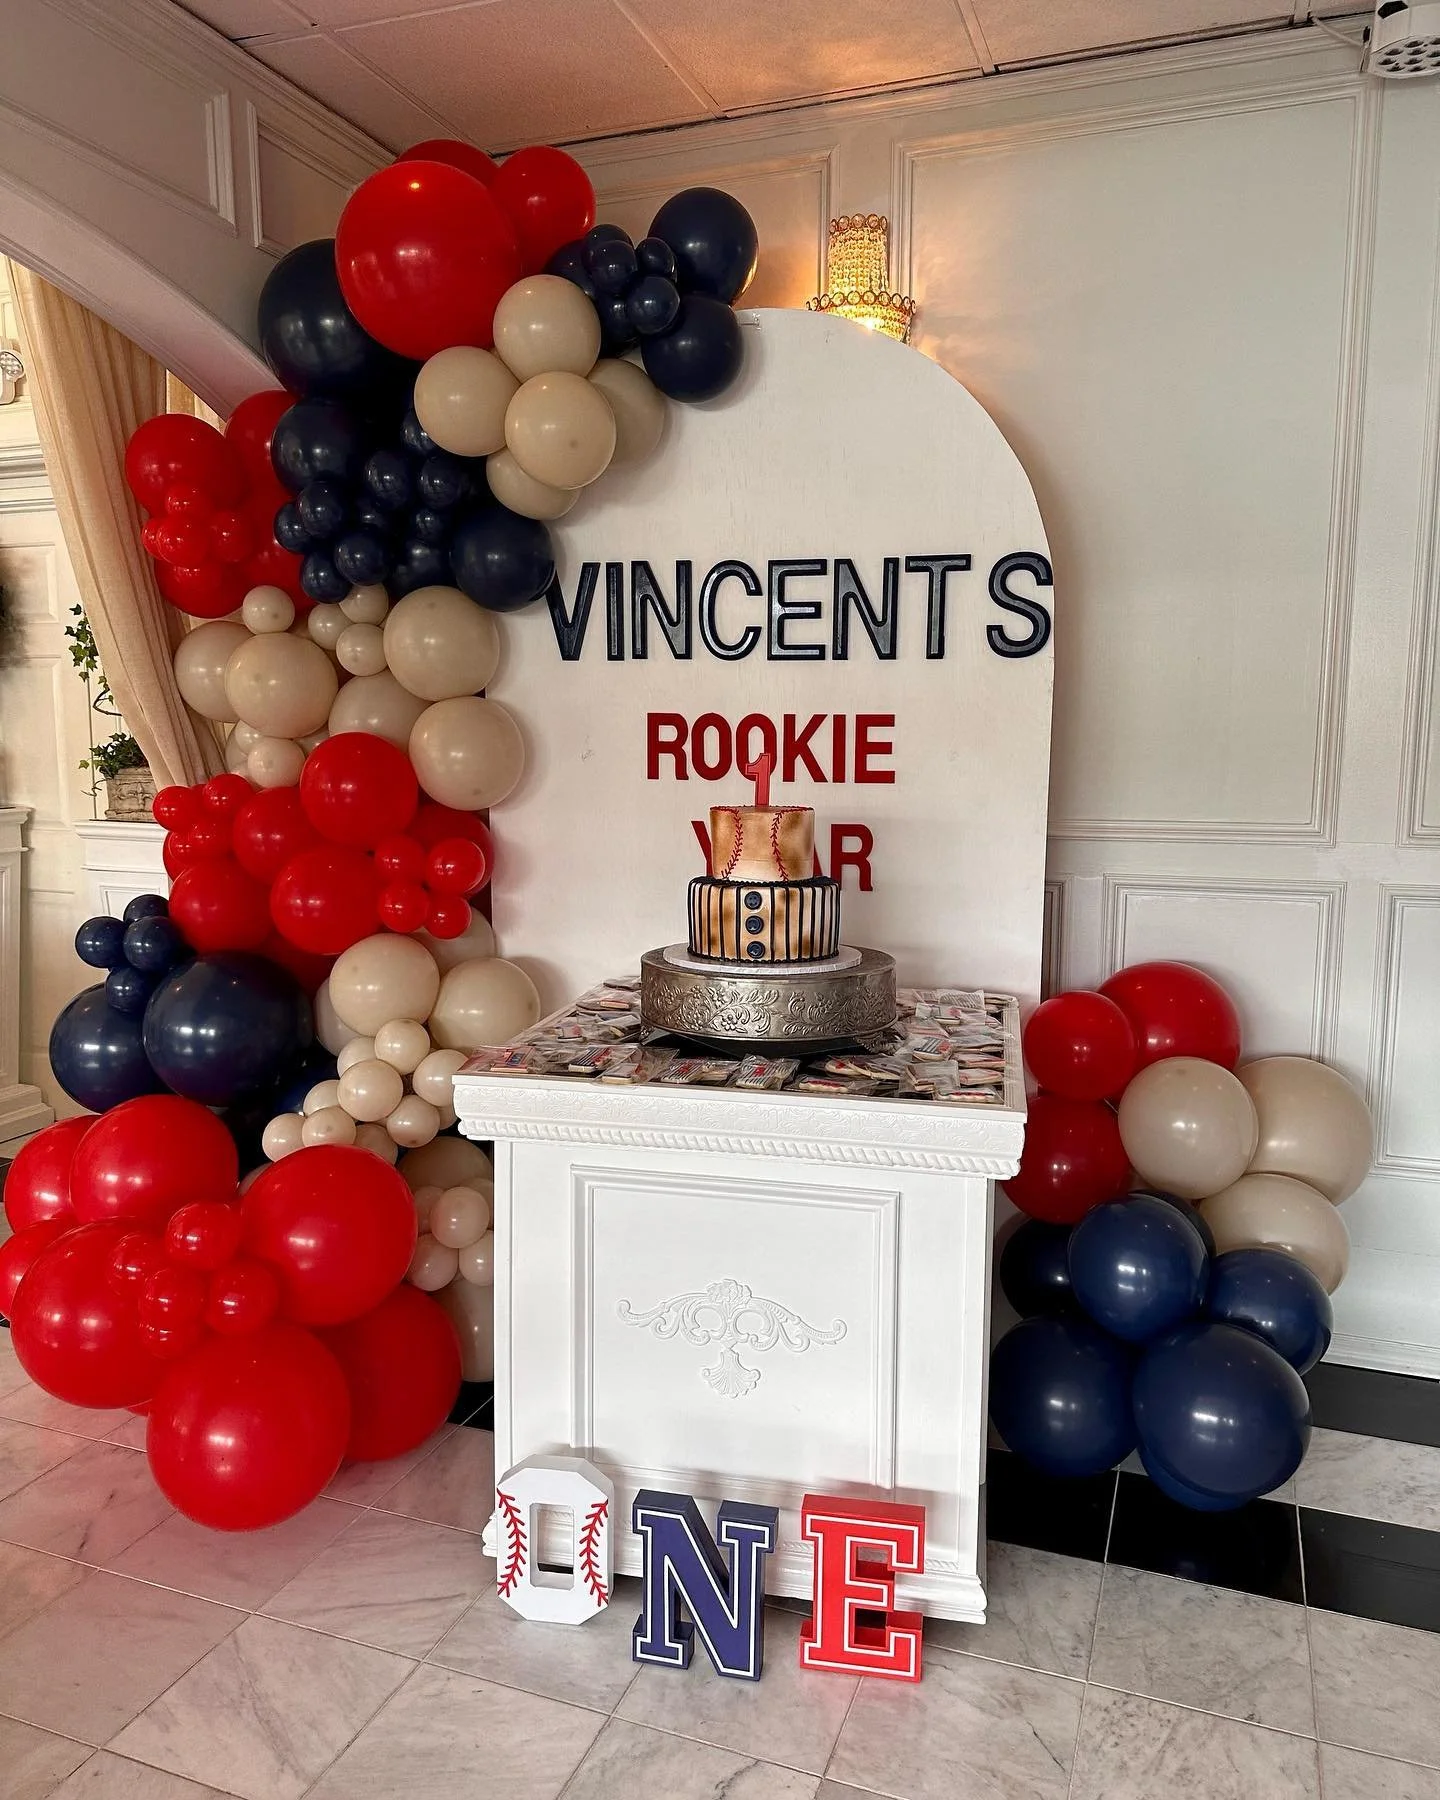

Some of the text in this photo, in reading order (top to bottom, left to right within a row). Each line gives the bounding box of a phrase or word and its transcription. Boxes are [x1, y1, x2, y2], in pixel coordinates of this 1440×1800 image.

[646, 712, 896, 784] ROOKIE
[745, 752, 771, 808] 1
[496, 1454, 927, 1683] ONE
